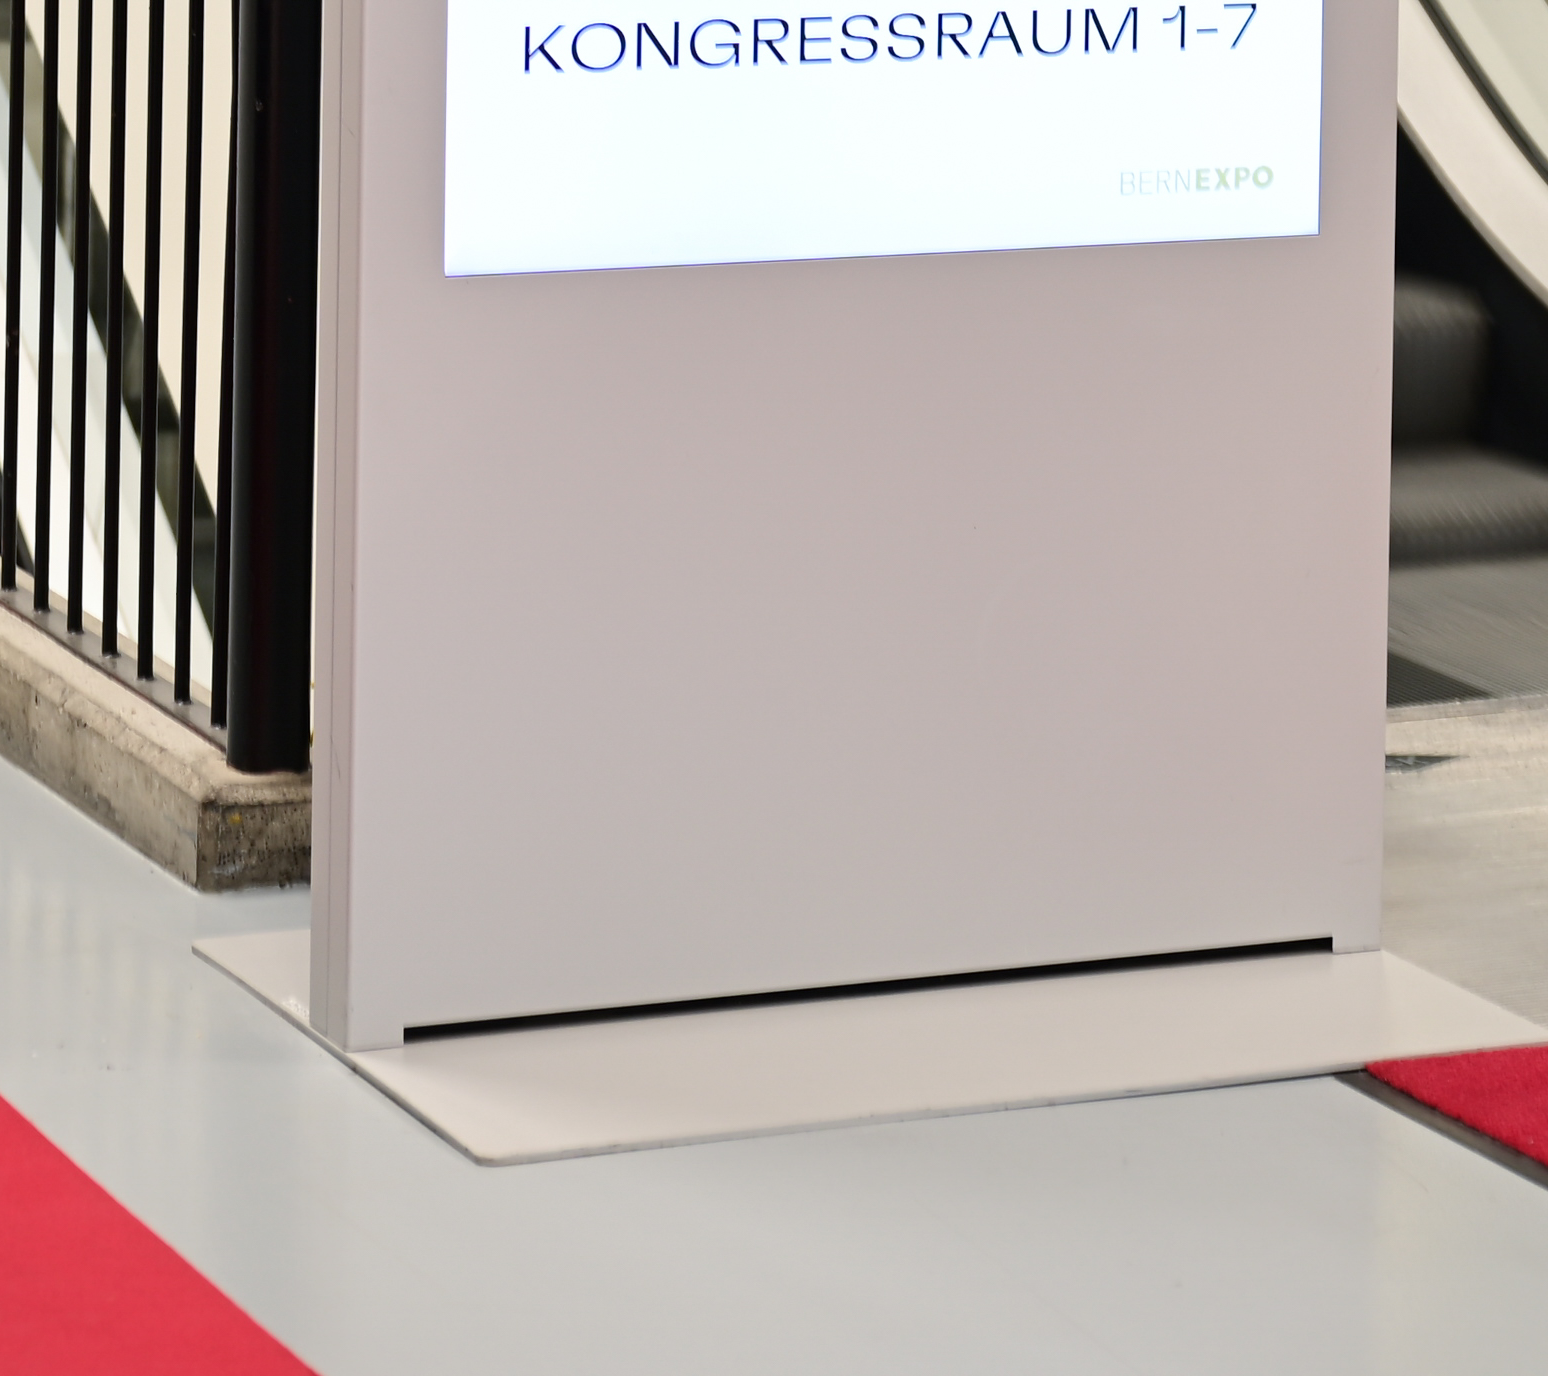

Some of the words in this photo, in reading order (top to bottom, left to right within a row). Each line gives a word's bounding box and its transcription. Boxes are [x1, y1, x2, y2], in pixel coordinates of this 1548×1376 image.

[524, 6, 1139, 75] KONGRESSRAUM
[1162, 3, 1258, 52] 1-7
[1120, 165, 1274, 196] BERNEXPO
